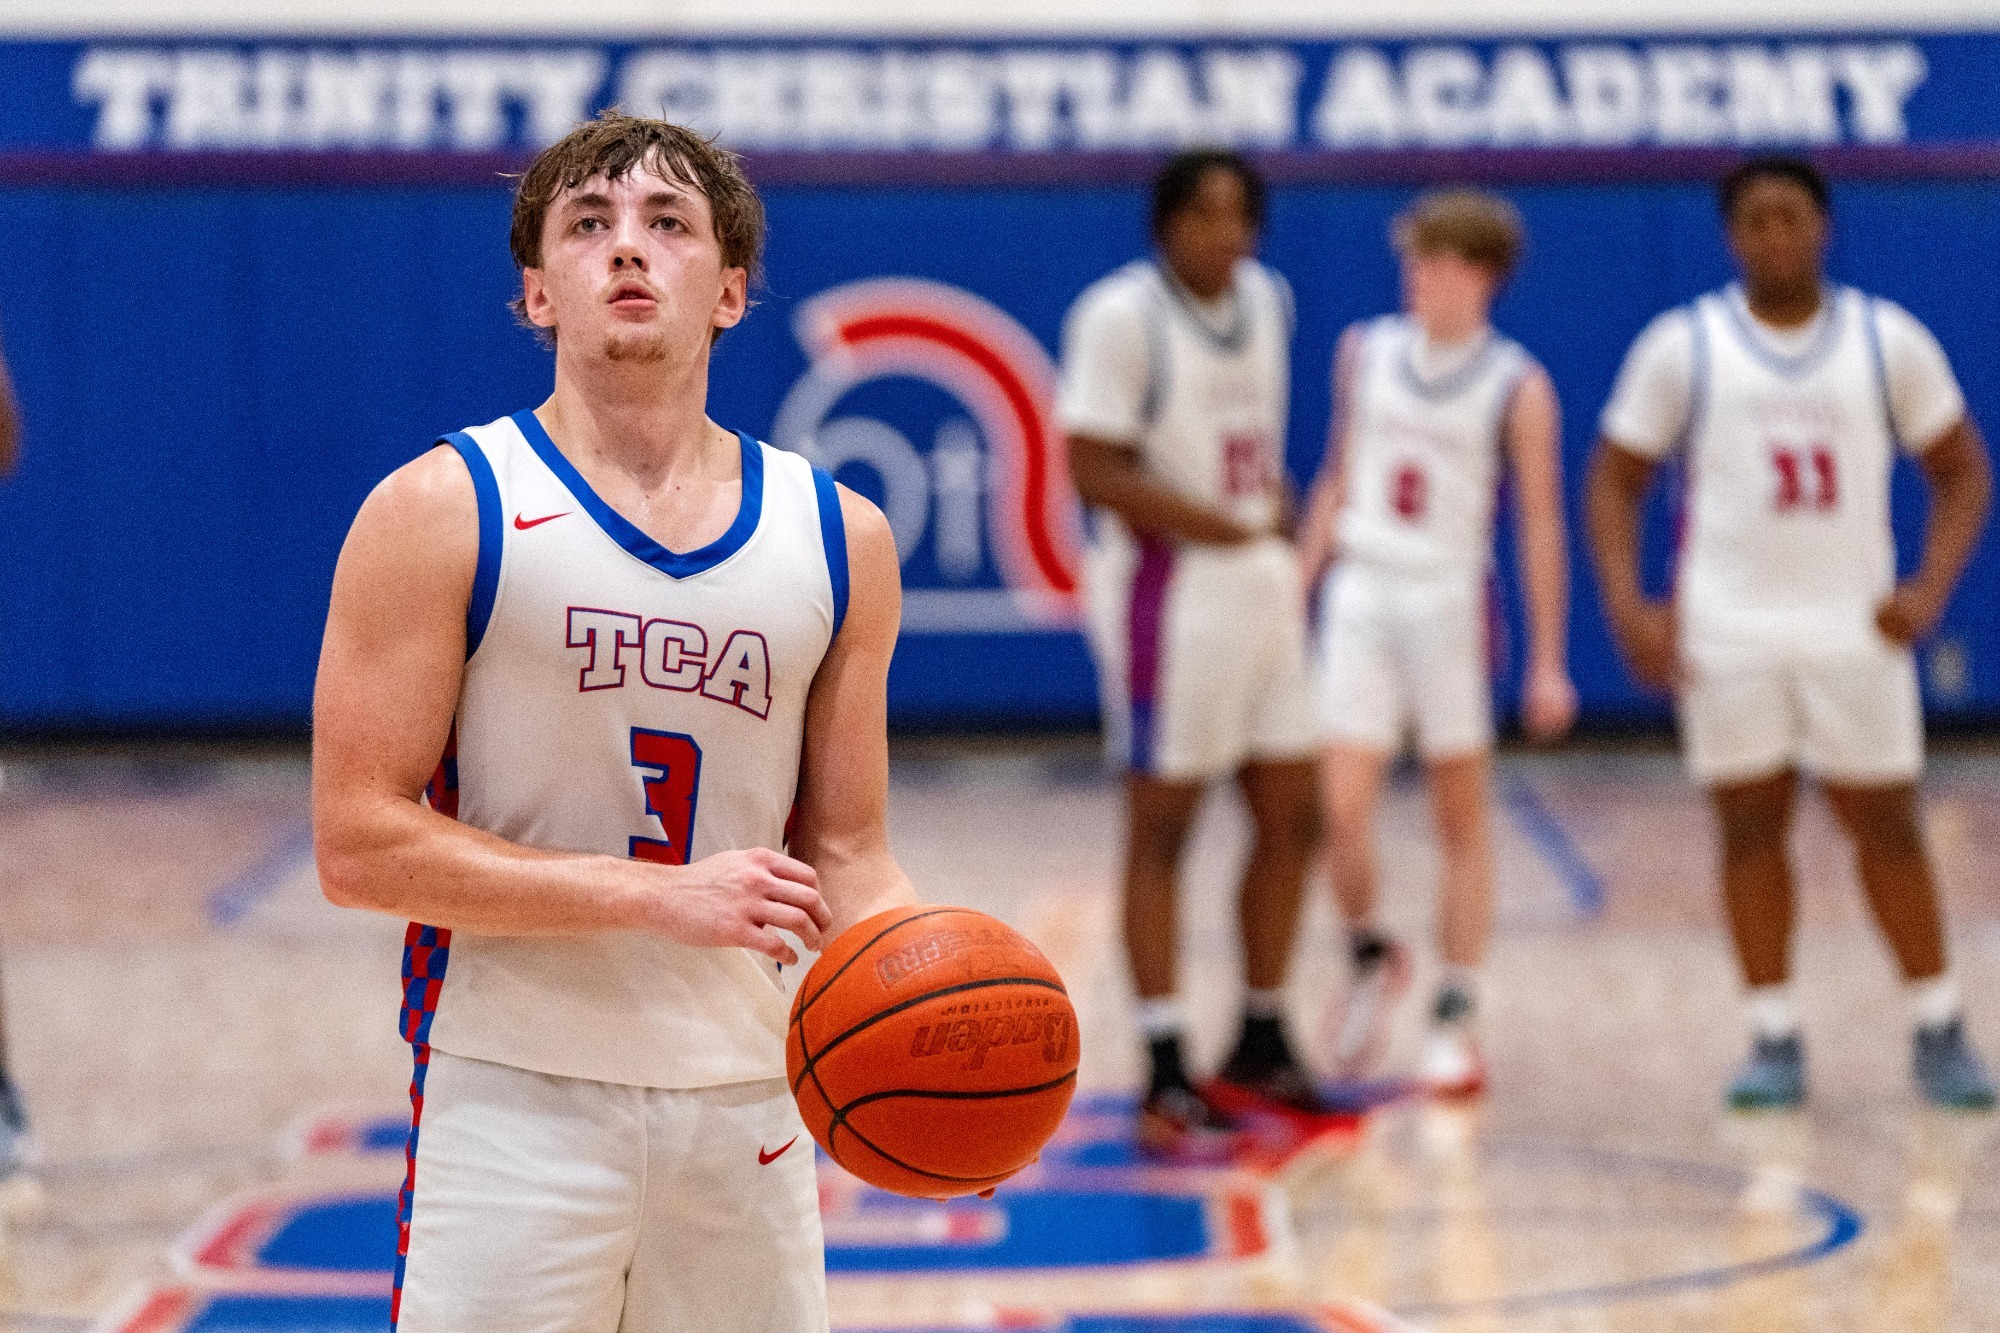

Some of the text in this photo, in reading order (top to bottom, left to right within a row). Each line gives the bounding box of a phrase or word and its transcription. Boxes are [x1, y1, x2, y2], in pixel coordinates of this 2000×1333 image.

[74, 43, 1924, 149] TRINITY CHRISTIAN ACADEMY
[566, 606, 772, 721] TCA
[629, 726, 702, 865] 3
[910, 1012, 1071, 1072] Baden
